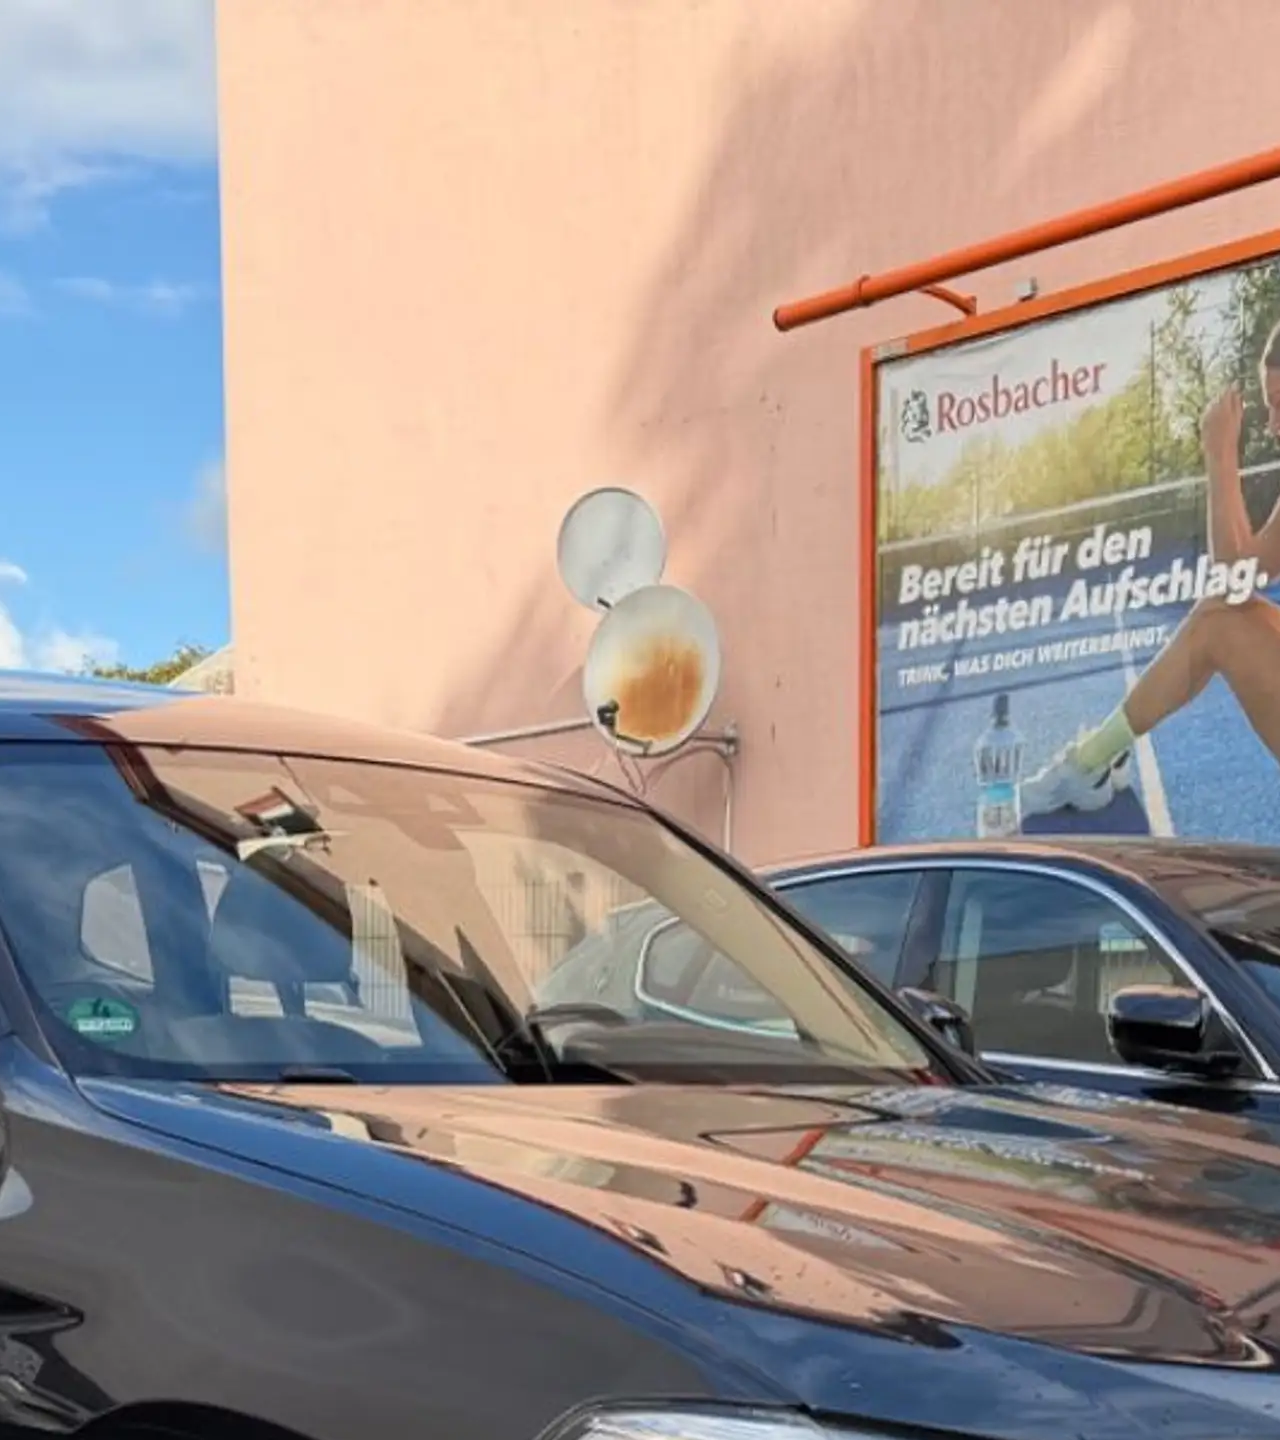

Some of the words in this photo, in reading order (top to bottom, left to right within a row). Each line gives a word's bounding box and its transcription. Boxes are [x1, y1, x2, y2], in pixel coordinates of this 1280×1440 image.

[936, 359, 1106, 433] Rosbacher
[898, 547, 1005, 604] Bereit
[1012, 534, 1070, 582] für
[1076, 523, 1153, 570] den
[897, 597, 1054, 651] nächsten
[1059, 554, 1269, 623] Aufschlag.
[953, 658, 991, 678] WAS
[992, 646, 1034, 671] DICH
